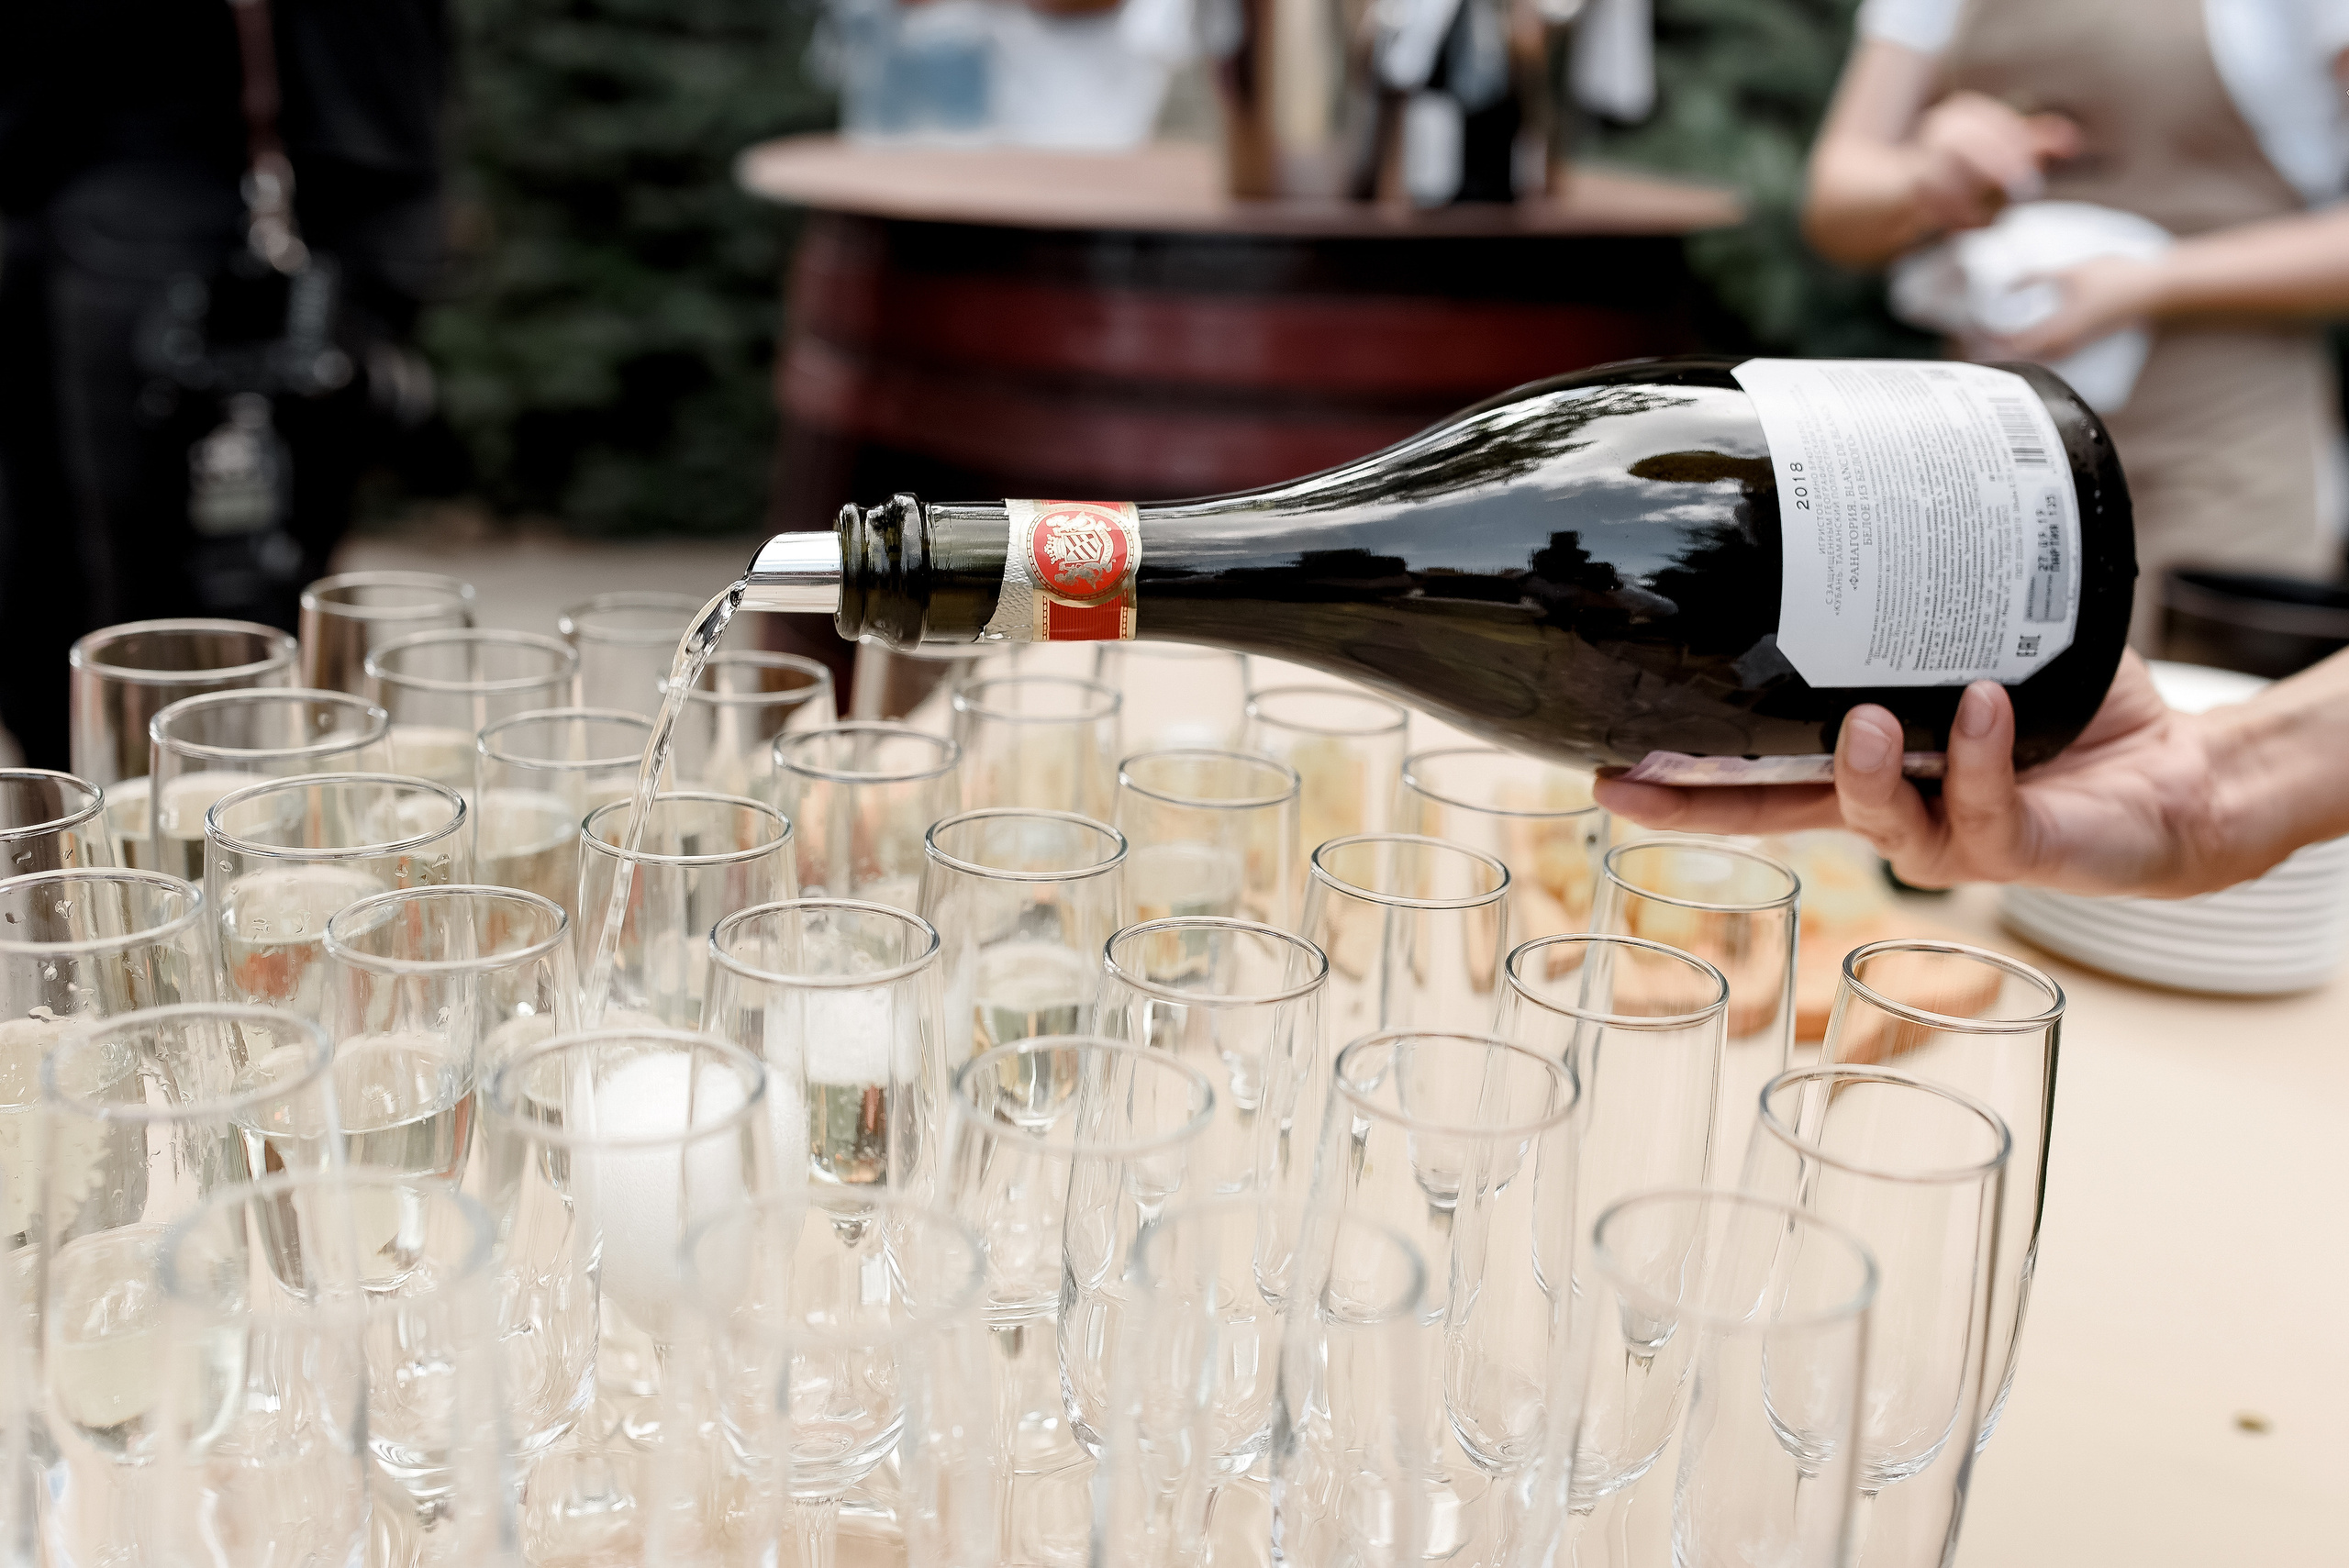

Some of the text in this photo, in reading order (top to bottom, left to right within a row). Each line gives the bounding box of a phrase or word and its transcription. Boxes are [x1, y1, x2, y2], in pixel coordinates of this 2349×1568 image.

[1833, 442, 1846, 456] DE
[1790, 462, 1809, 510] 2018
[1811, 473, 1820, 499] ВИНО
[1839, 458, 1855, 496] BLANC
[1857, 484, 1868, 500] ИЗ
[1815, 503, 1825, 554] ИГРИСТОЕ
[1831, 502, 1842, 564] ТАМАНСКИЙ
[1861, 504, 1873, 545] БЕЛОЕ
[1823, 518, 1835, 595] ЗАЩИЩЕННЫМ
